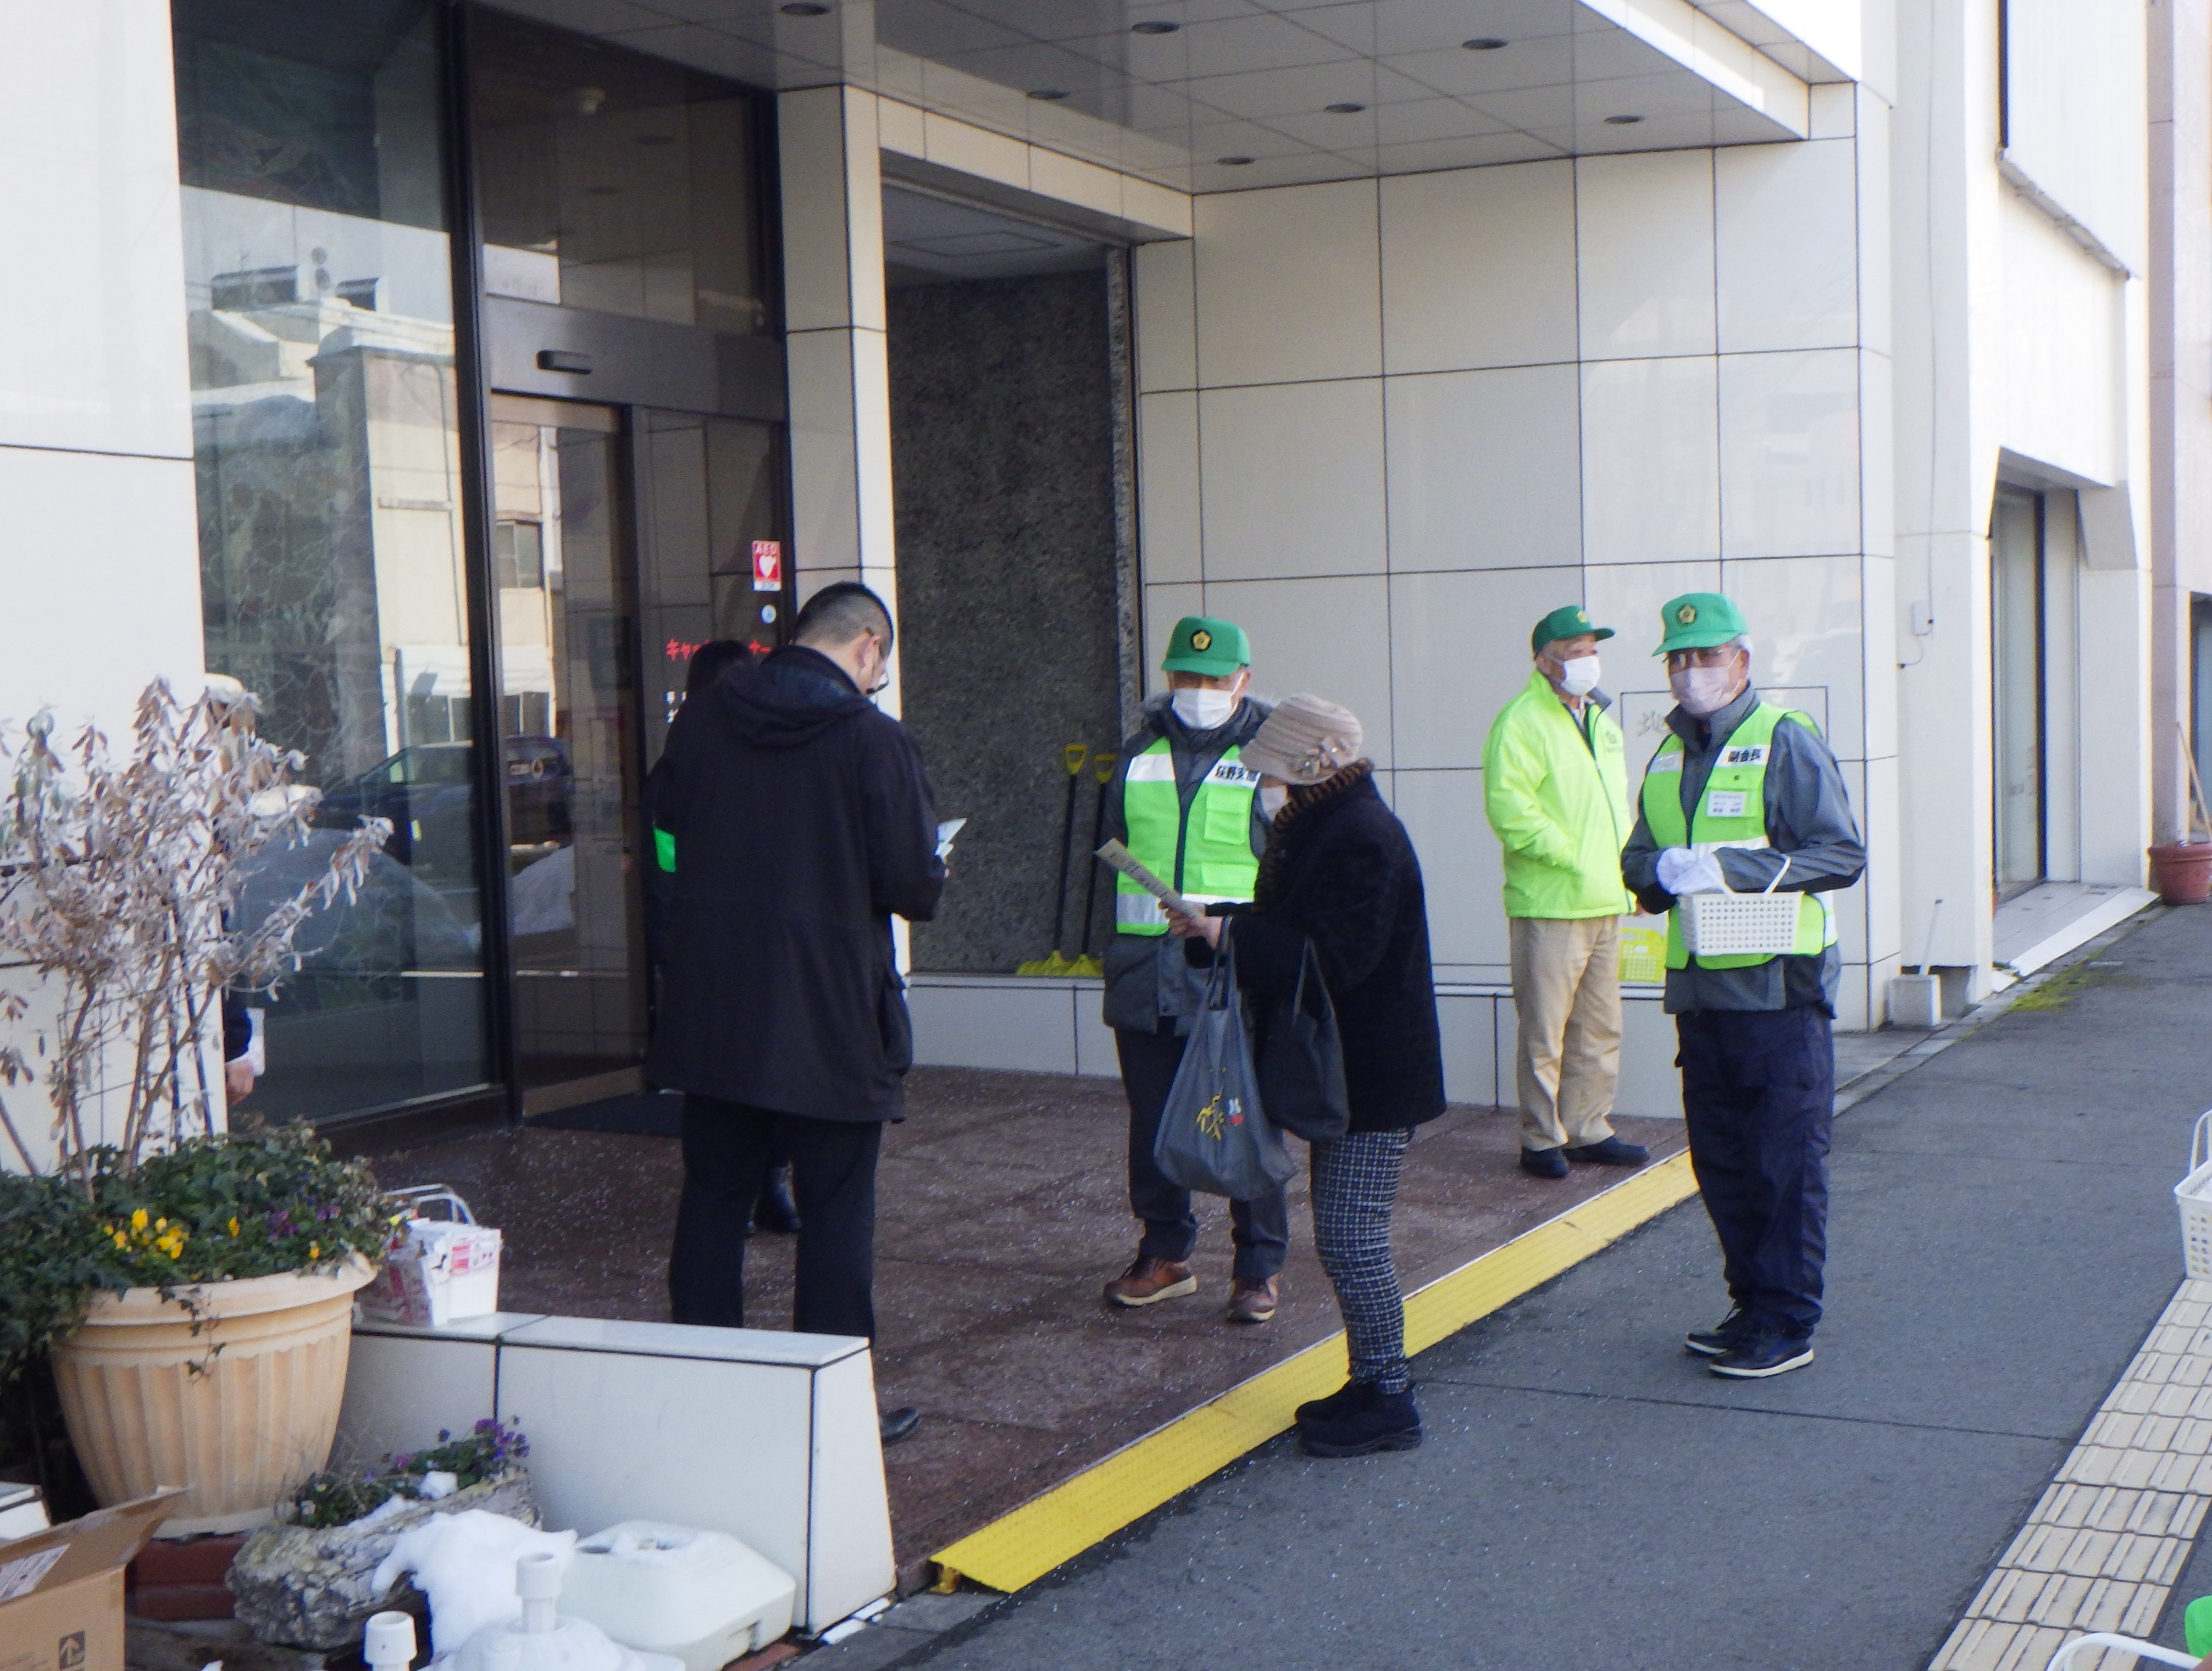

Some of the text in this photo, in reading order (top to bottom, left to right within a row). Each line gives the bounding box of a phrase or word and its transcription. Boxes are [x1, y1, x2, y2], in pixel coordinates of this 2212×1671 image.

[754, 542, 778, 555] AED
[1728, 748, 1762, 763] 副会長
